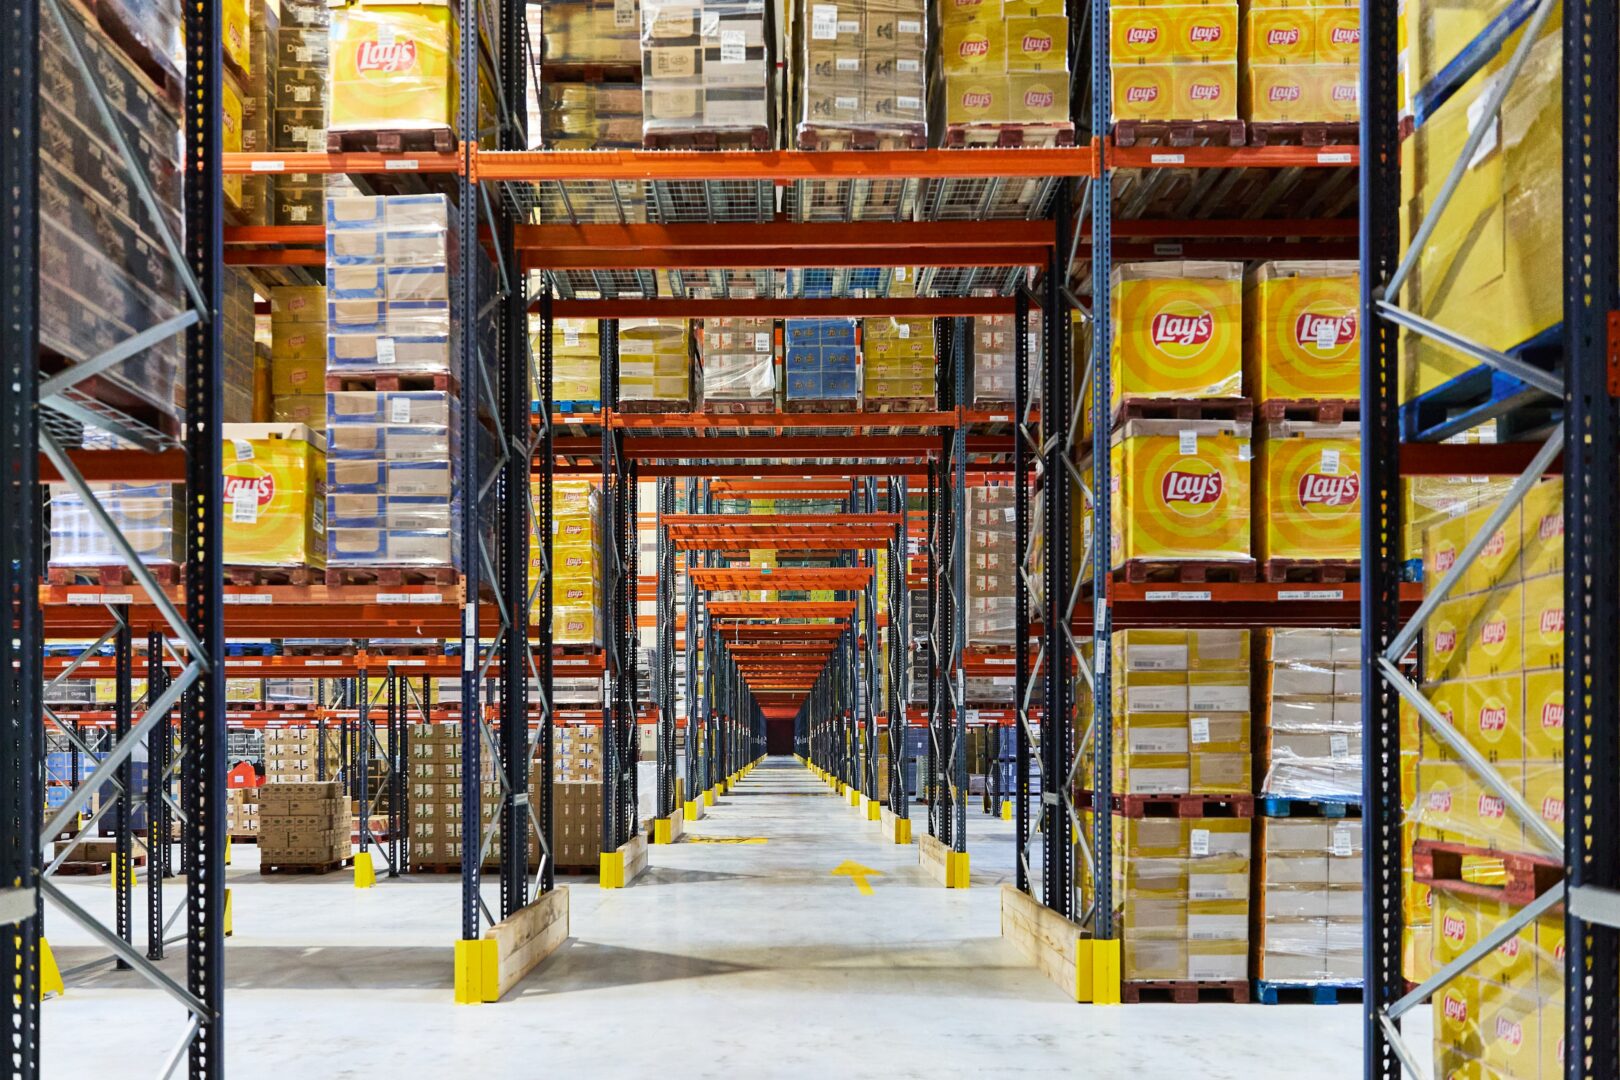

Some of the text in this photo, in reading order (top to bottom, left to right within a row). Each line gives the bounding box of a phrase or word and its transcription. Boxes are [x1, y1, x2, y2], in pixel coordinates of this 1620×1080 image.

[1129, 27, 1157, 43] Lay's
[1192, 25, 1220, 42] Lay's
[1269, 27, 1298, 45] Lay's
[961, 40, 988, 57] Lay's
[1024, 36, 1050, 51] Lay's
[360, 40, 414, 72] Lay's
[1025, 91, 1052, 107] Lay's
[1128, 85, 1157, 102] Lay's
[1192, 83, 1220, 100] Lay's
[1270, 85, 1299, 102] Lay's
[963, 92, 991, 109] Lay's
[1156, 312, 1210, 345] Lay's
[1166, 471, 1219, 504] Lay's
[1302, 472, 1356, 507] Lay's
